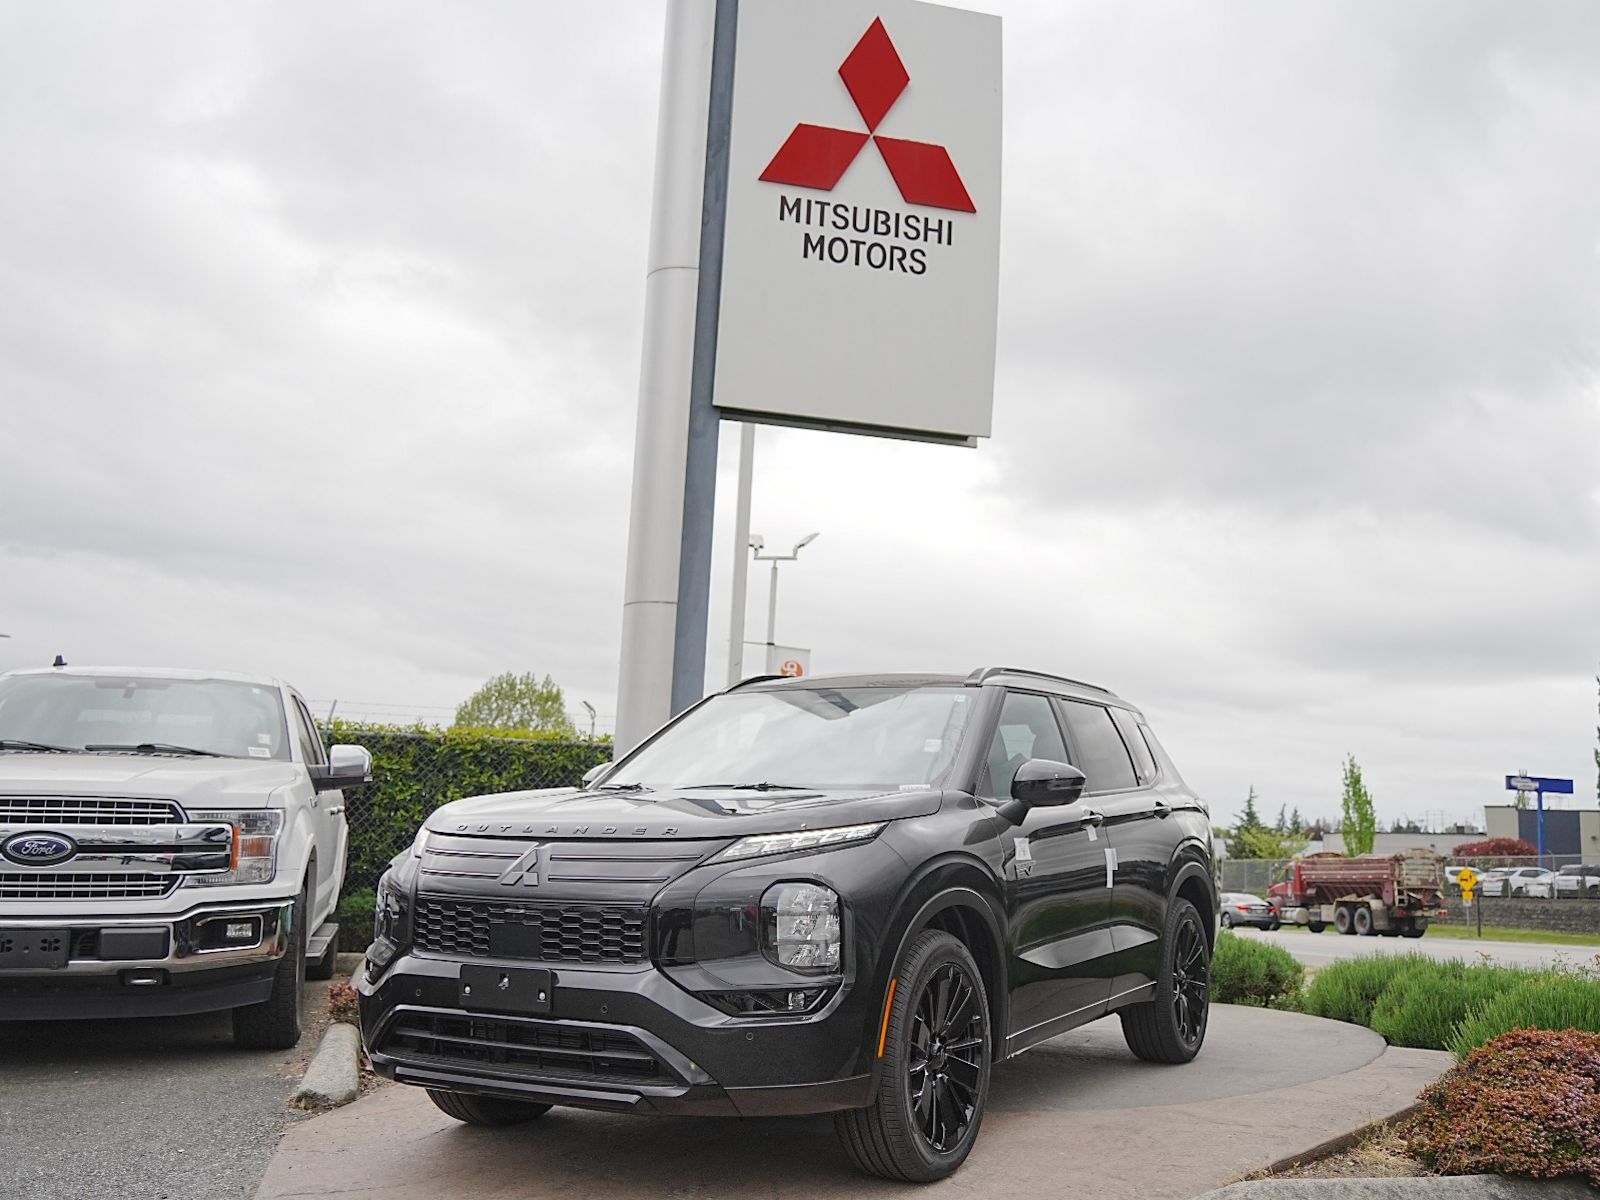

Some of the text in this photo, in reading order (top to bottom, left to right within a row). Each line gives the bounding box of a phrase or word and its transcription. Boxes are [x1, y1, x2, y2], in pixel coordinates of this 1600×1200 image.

[779, 195, 953, 246] MITSUBISHI
[803, 233, 927, 275] MOTORS
[455, 823, 679, 836] OUTLANDER
[21, 840, 57, 855] Ford
